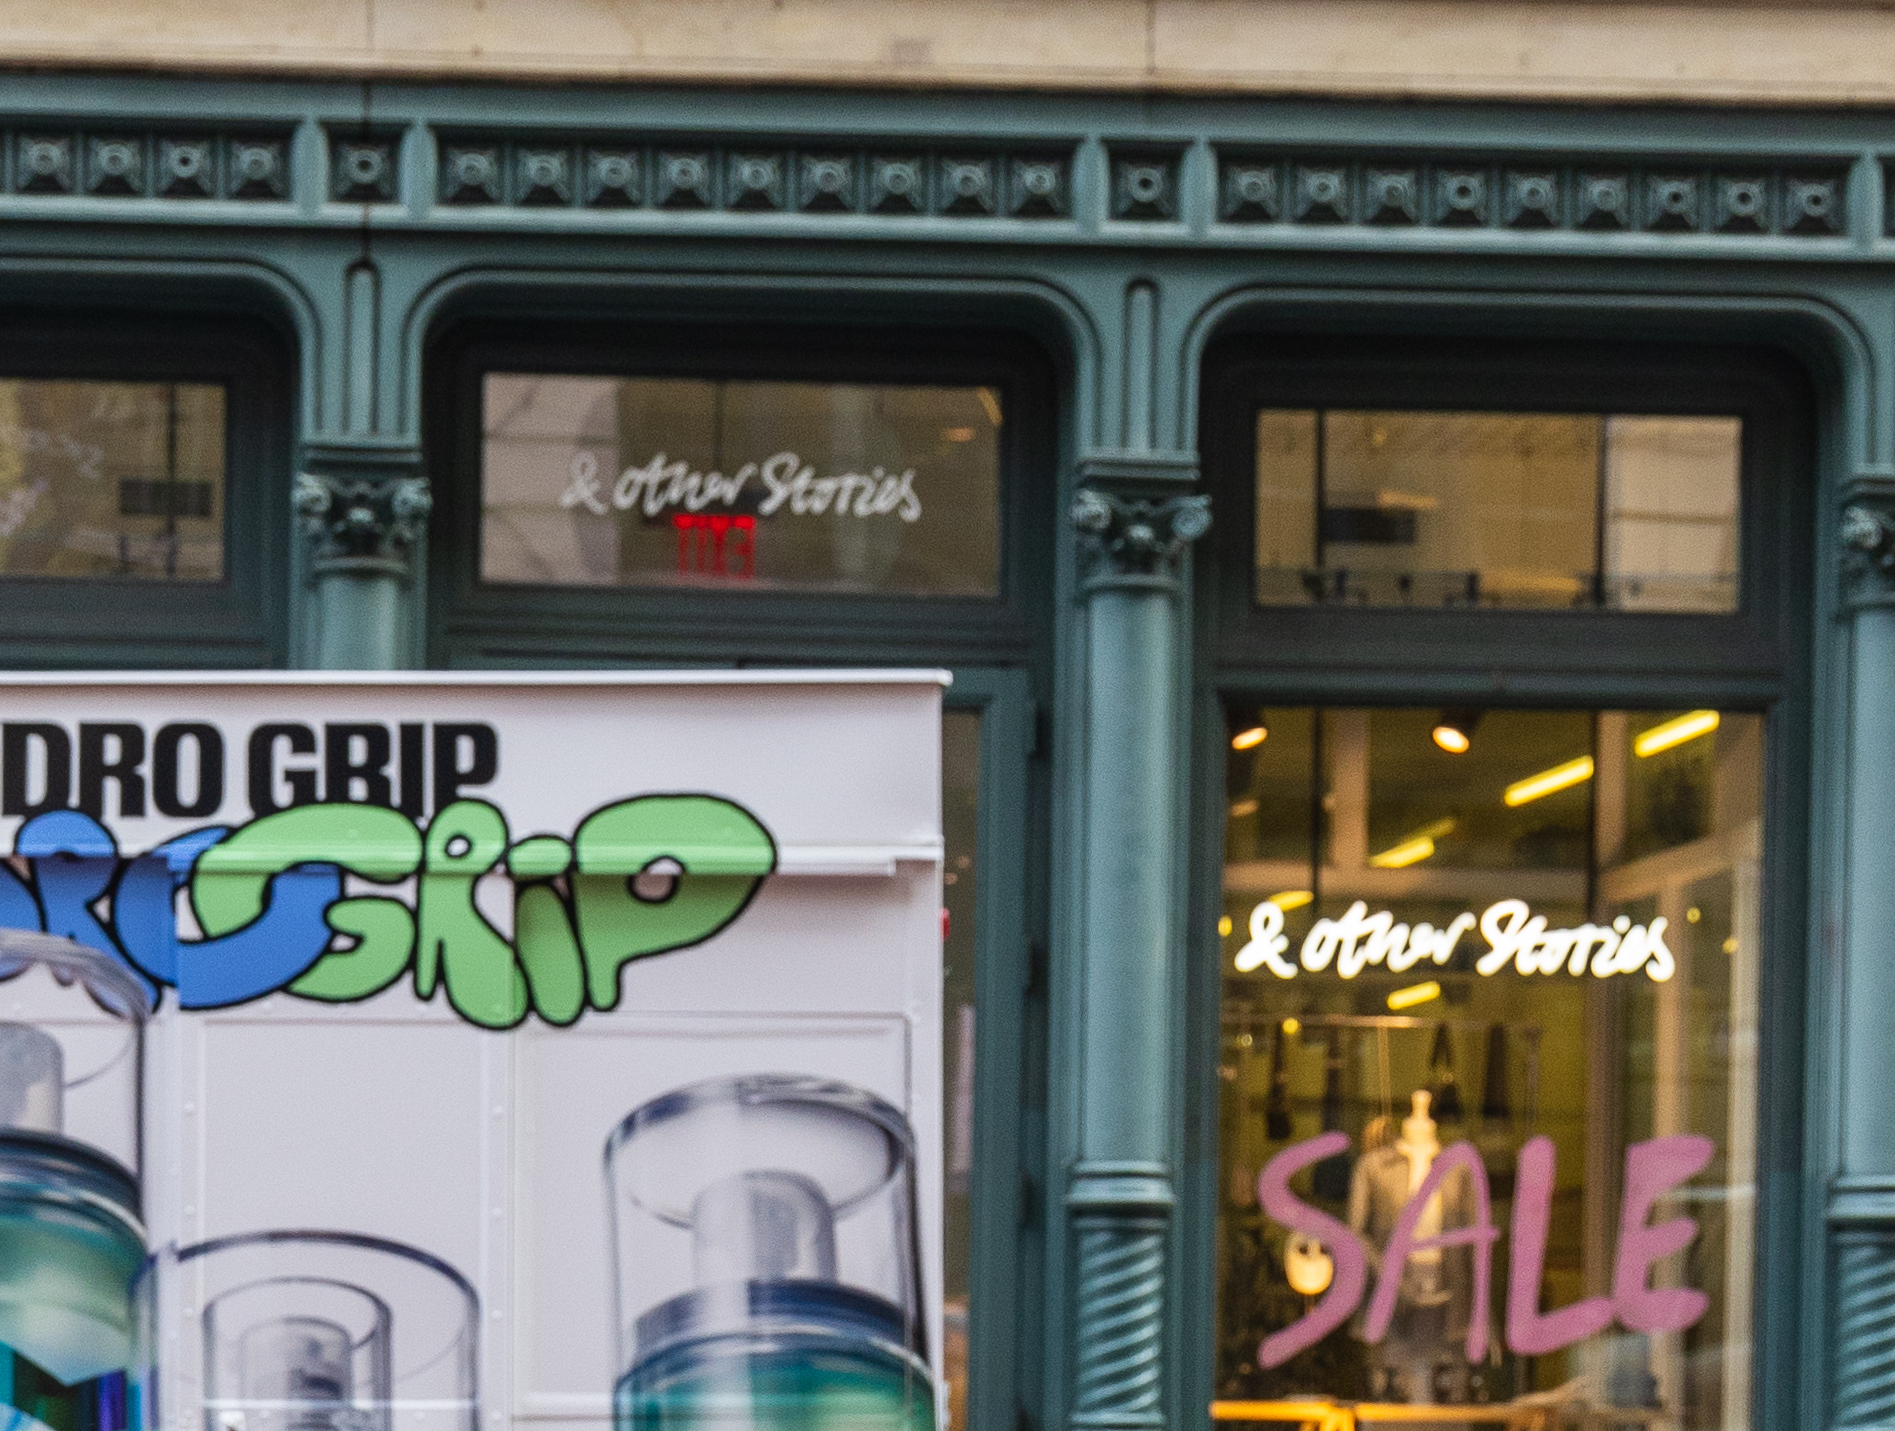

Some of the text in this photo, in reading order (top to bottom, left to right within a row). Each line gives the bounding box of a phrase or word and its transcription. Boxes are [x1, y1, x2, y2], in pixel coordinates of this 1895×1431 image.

[560, 451, 923, 522] & other Stories
[247, 721, 499, 817] GRIP
[1234, 898, 1675, 983] & other Stories
[1256, 1130, 1715, 1368] SALE
